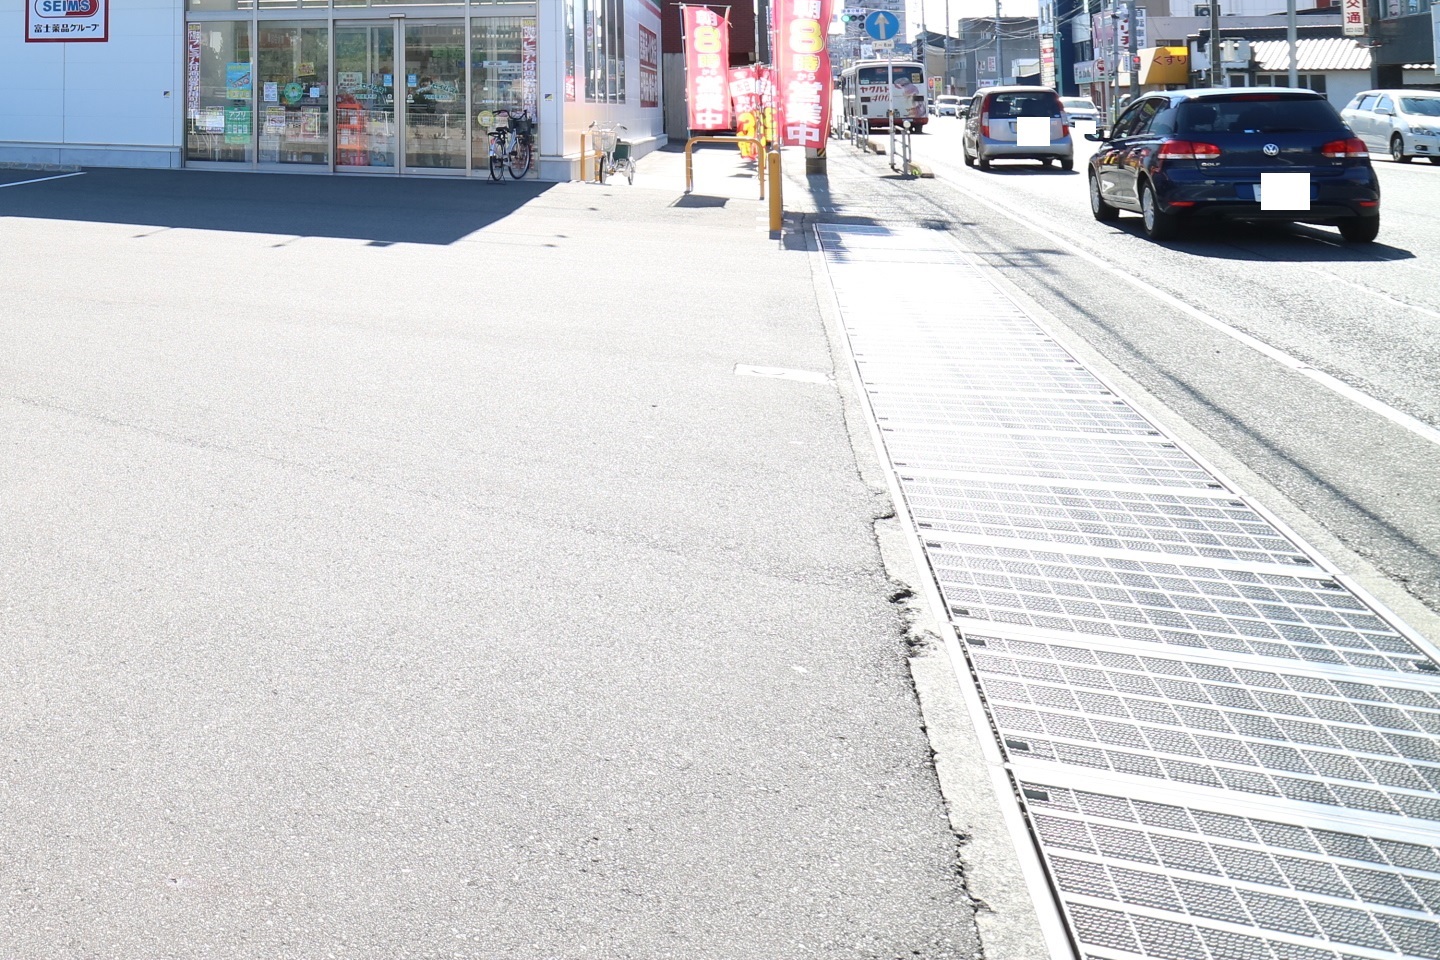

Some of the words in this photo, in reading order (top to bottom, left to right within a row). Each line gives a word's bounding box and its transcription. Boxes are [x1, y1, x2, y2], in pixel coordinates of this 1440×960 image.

[42, 0, 91, 12] SEIMS
[34, 23, 100, 33] 富士薬品グループ
[1153, 55, 1187, 65] くすり
[860, 85, 889, 93] ヤクルト
